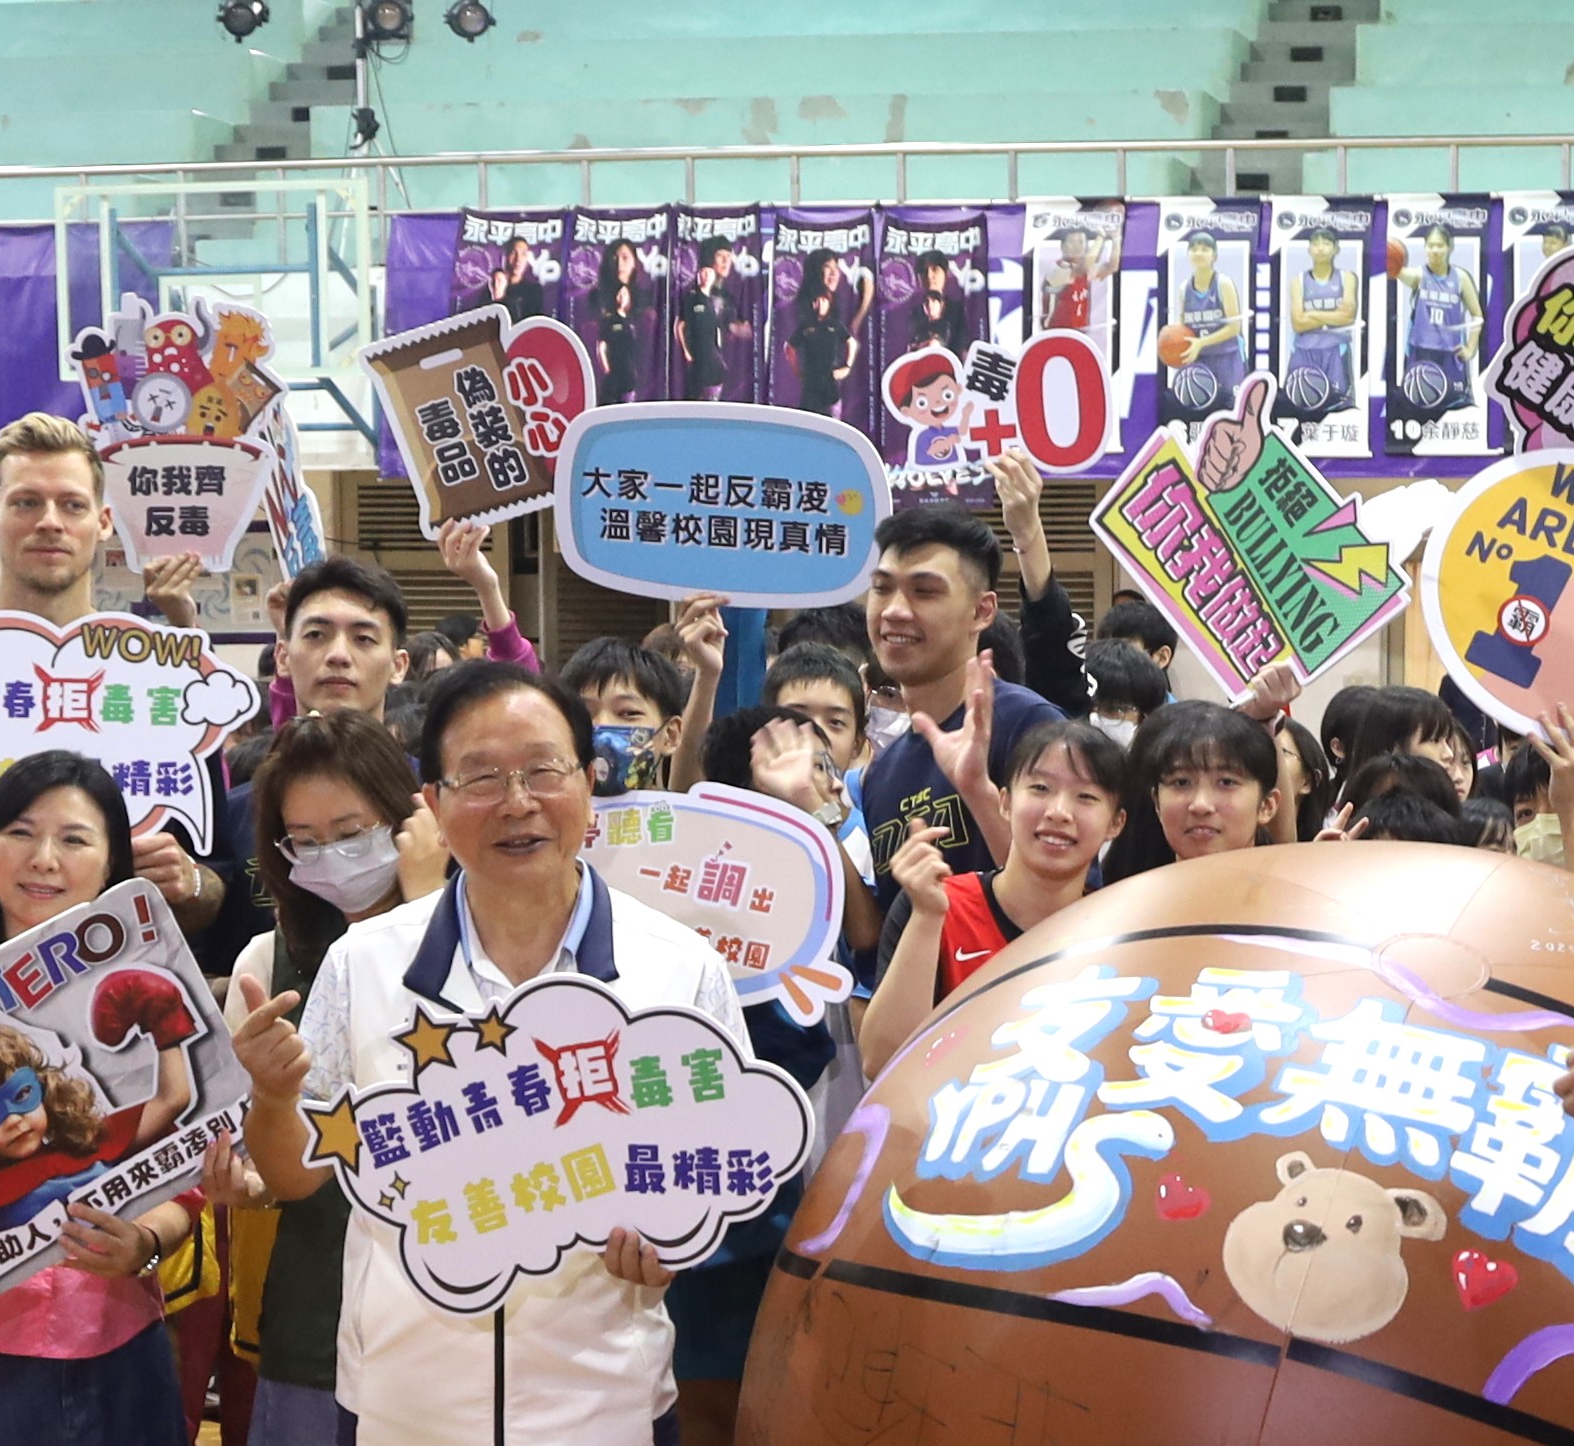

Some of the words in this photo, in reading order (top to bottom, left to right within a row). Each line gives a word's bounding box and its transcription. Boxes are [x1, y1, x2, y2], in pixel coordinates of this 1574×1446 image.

[966, 347, 1017, 402] 毒
[455, 366, 528, 490] 偽裝的
[507, 361, 567, 452] 小心
[1389, 419, 1422, 441] 10
[417, 399, 477, 484] 毒品
[128, 464, 226, 496] 你我齊
[581, 467, 830, 515] 大家一起反霸凌
[1258, 457, 1319, 529] 拒絕
[144, 505, 209, 537] 反毒
[1224, 488, 1341, 654] BULLYING
[80, 622, 205, 669] WOW!
[96, 756, 195, 799] 精彩
[639, 840, 776, 914] 一起調出
[624, 1143, 774, 1196] 最精彩
